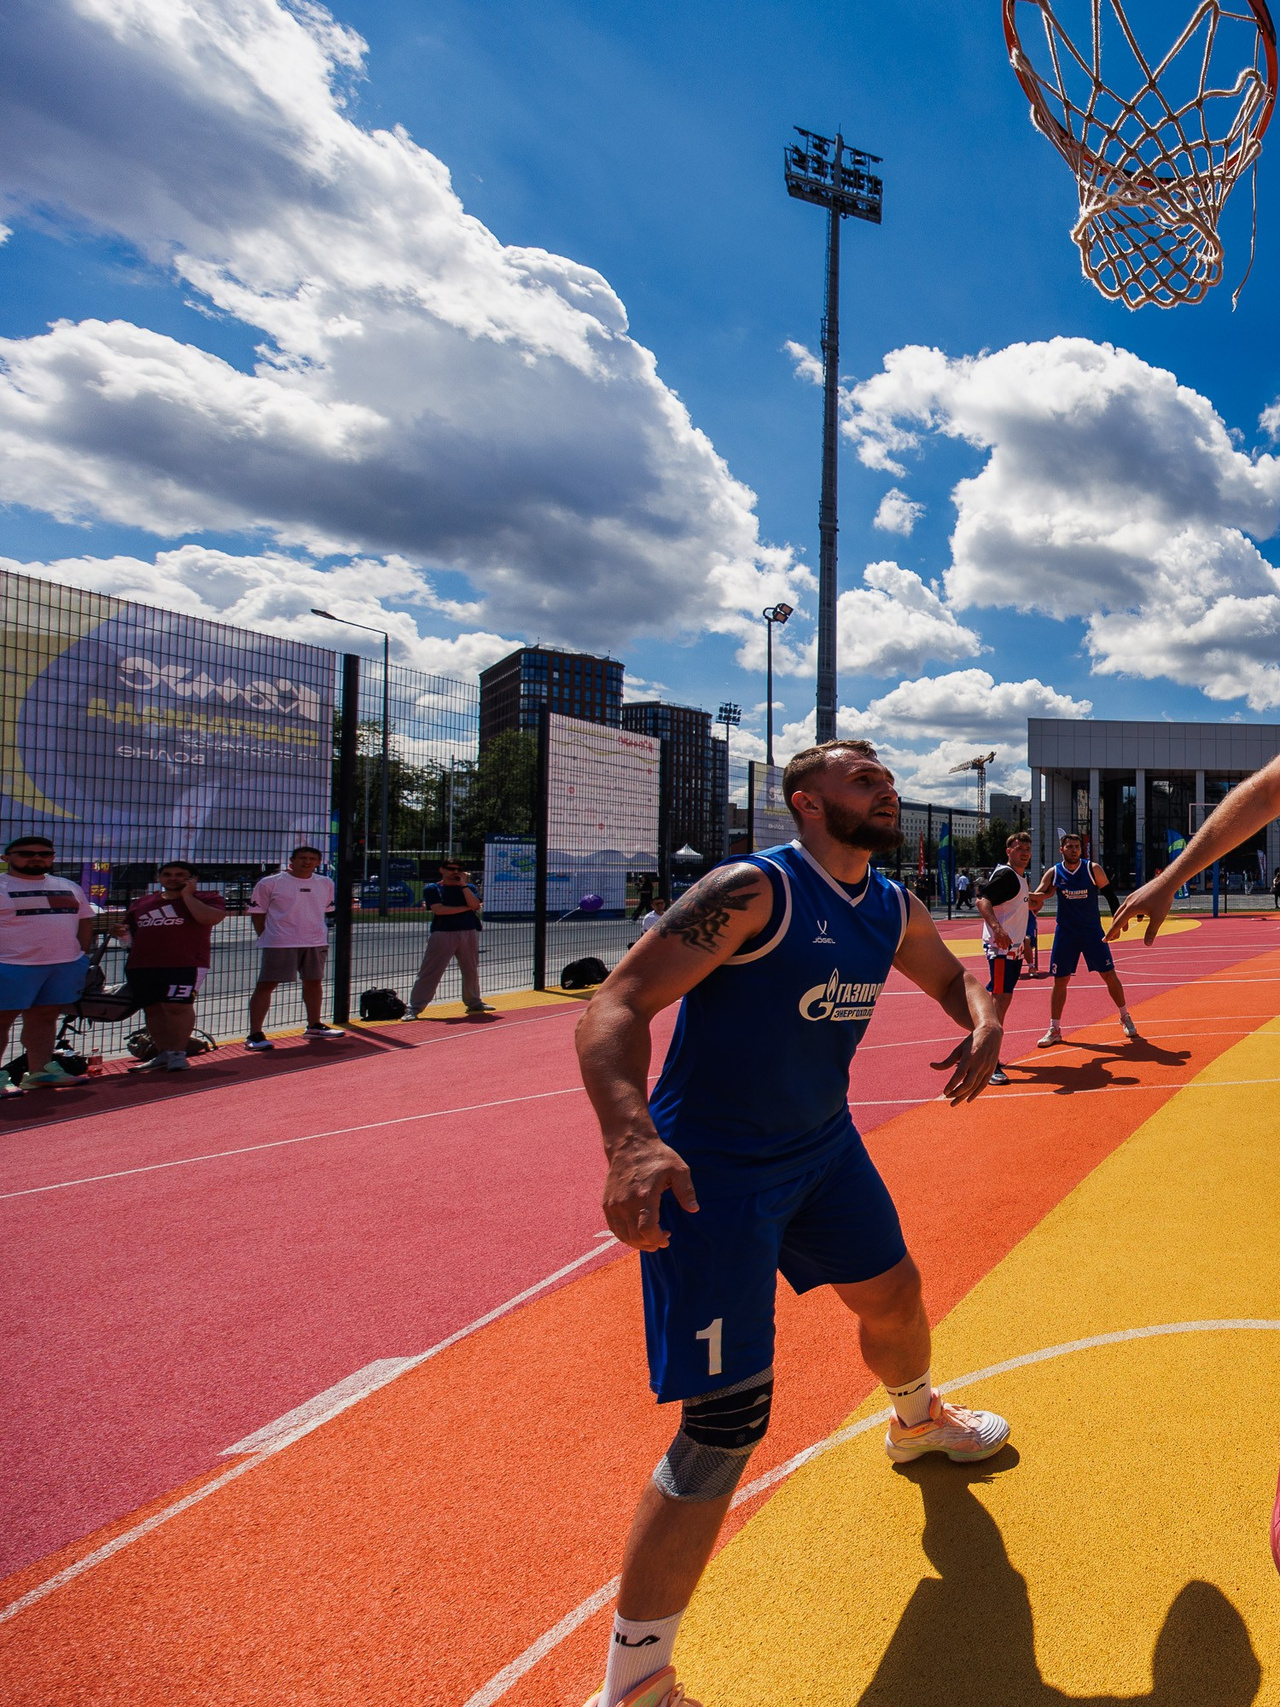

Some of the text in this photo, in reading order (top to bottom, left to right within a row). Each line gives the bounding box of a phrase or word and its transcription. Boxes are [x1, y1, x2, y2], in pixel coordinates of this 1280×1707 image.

[137, 916, 184, 928] adidas
[167, 984, 193, 998] 13
[695, 1317, 723, 1376] 1
[614, 1631, 661, 1647] ILA
